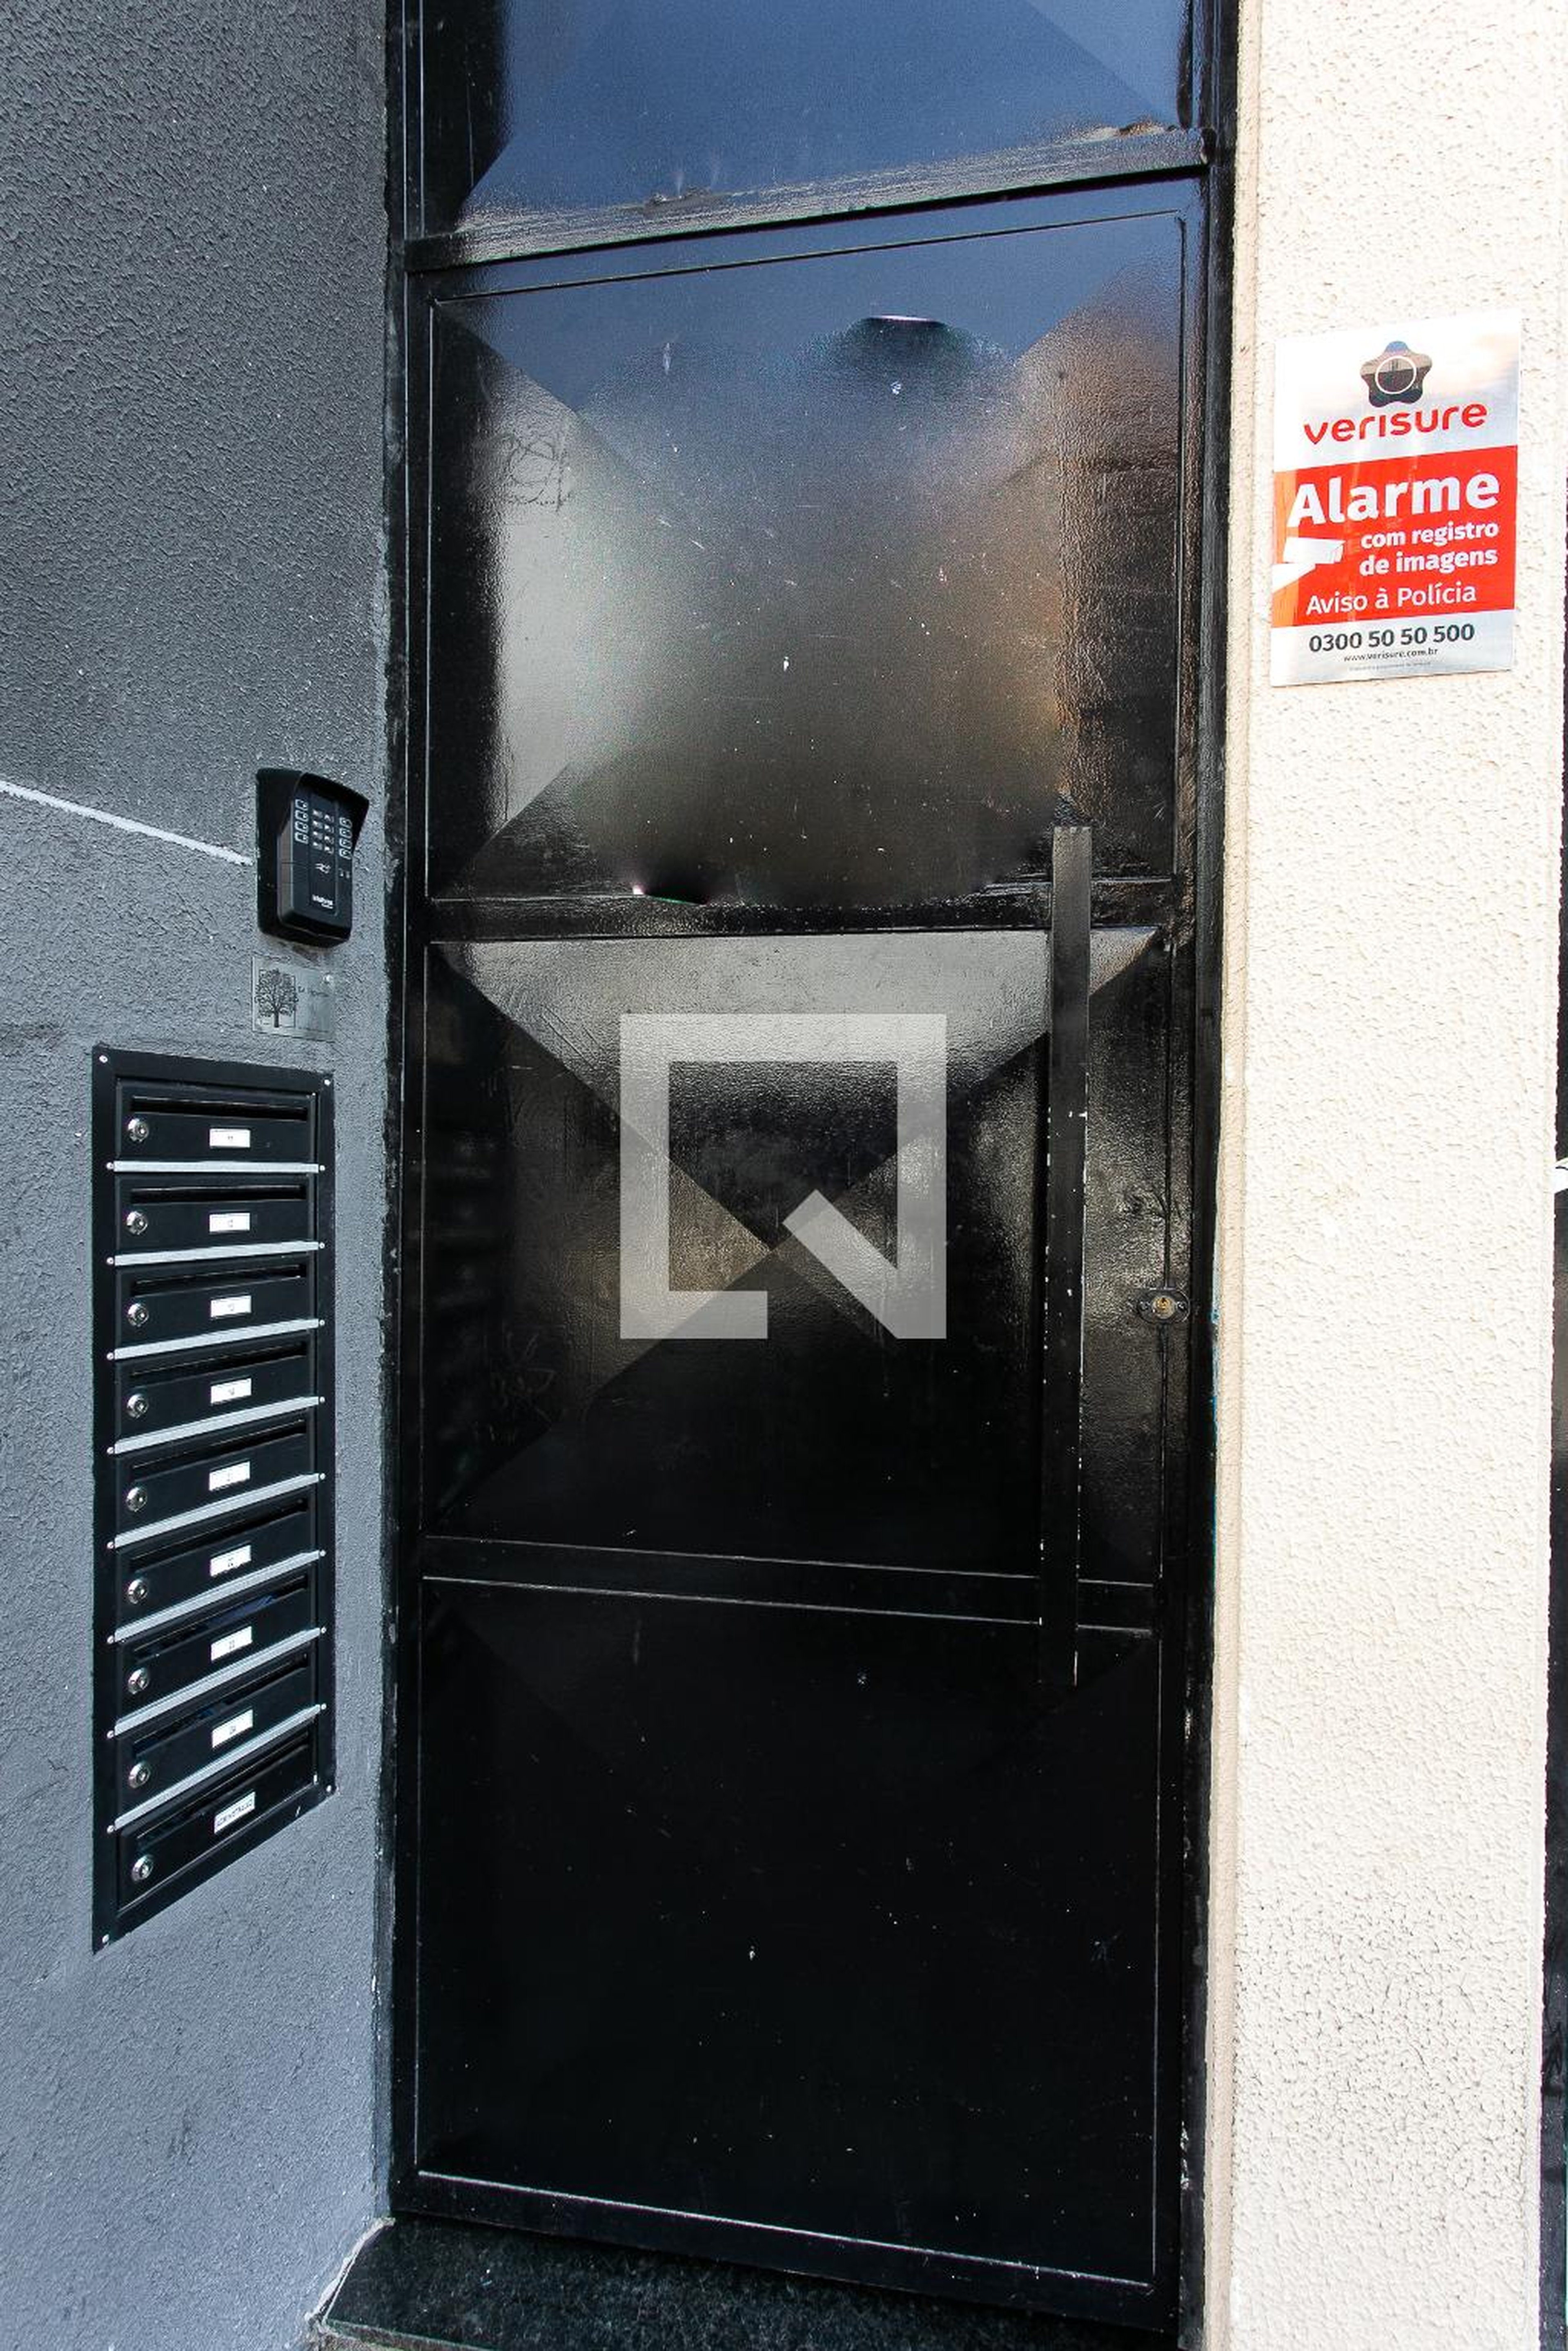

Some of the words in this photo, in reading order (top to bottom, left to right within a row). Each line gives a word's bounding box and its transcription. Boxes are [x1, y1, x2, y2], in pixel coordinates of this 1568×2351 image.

[1304, 403, 1488, 445] verisure
[1288, 472, 1499, 527] Alarme
[1360, 529, 1406, 549] com
[1411, 520, 1499, 548] registro
[1359, 558, 1389, 577] de
[1396, 548, 1498, 574] imagens
[1306, 591, 1368, 615] Aviso
[1375, 587, 1389, 609] à
[1397, 582, 1477, 607] Polícia
[1309, 632, 1362, 653] 0300
[1368, 629, 1395, 648] 50
[1401, 627, 1428, 646] 50
[1432, 623, 1475, 643] 500
[1343, 648, 1439, 662] www.verisure.com.br
